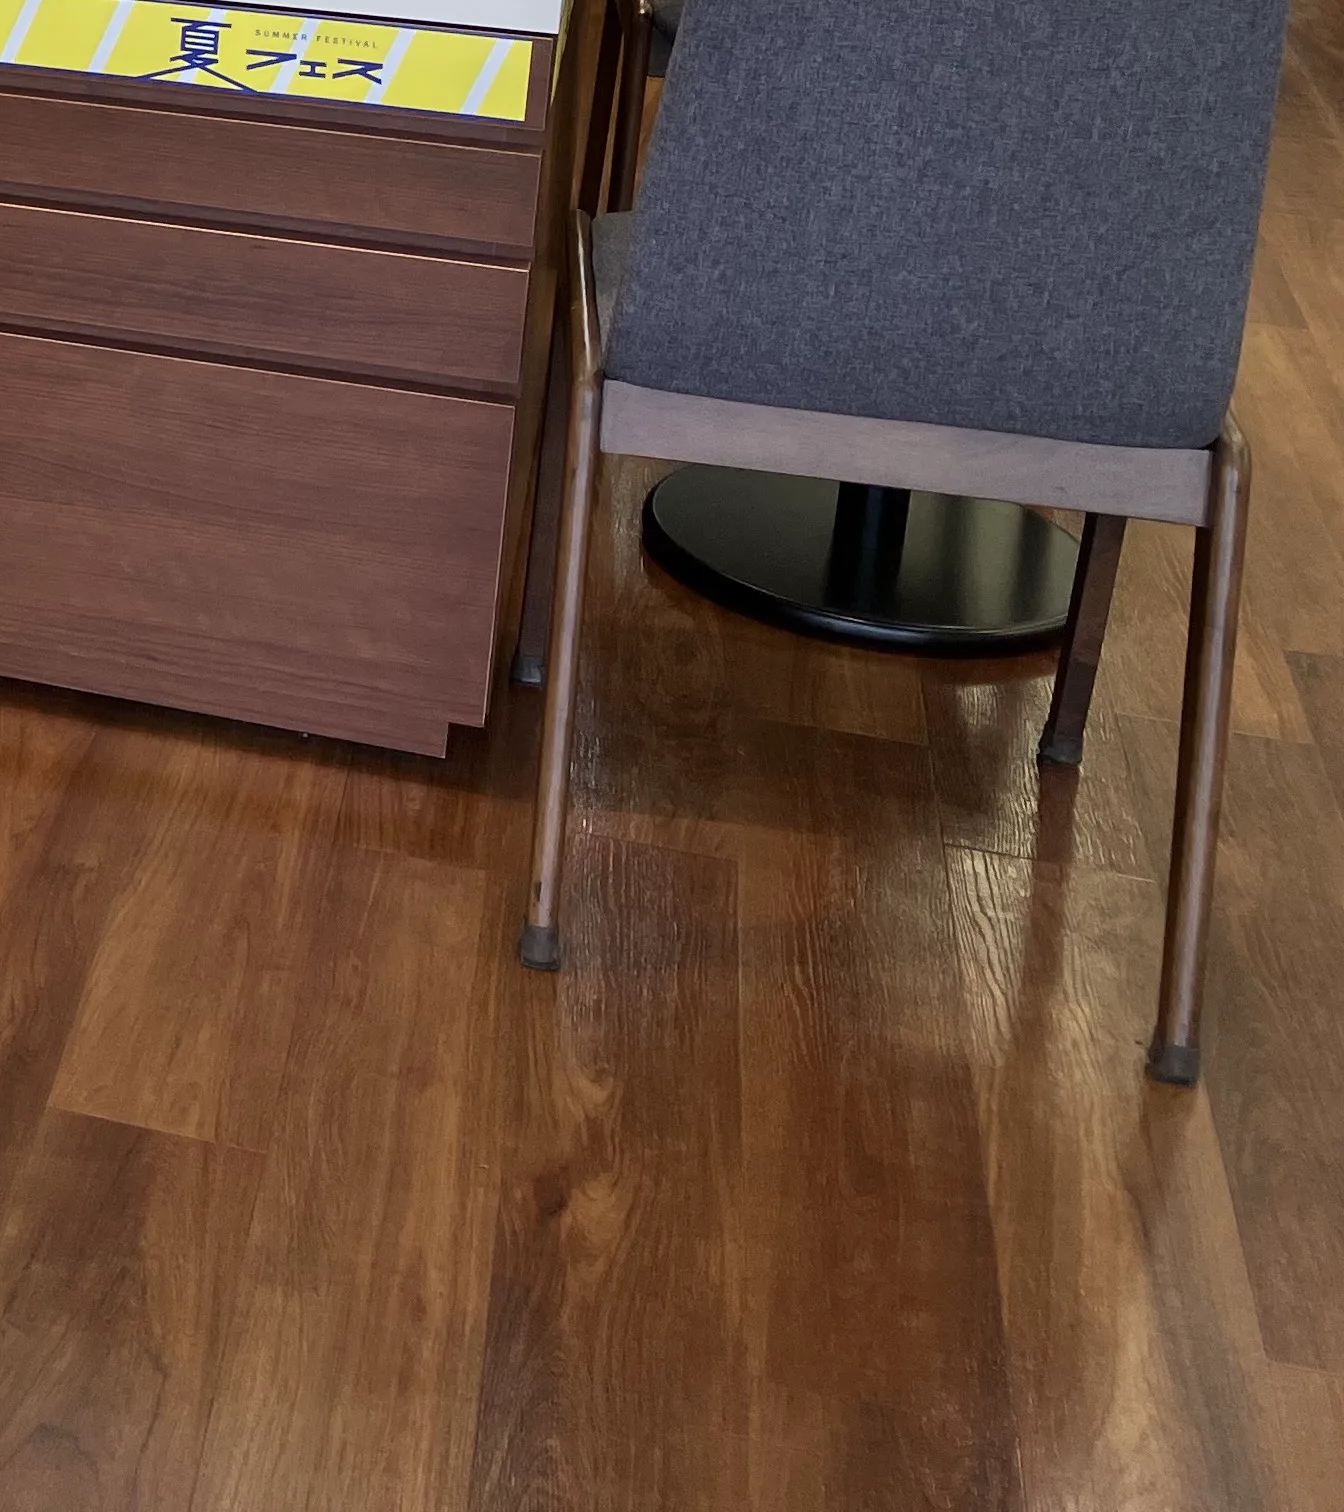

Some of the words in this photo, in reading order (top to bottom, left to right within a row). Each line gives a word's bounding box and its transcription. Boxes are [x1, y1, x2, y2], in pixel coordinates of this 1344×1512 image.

[134, 17, 384, 93] 夏フェス
[255, 29, 308, 41] SUMMER
[316, 35, 378, 49] FESTIVAL
